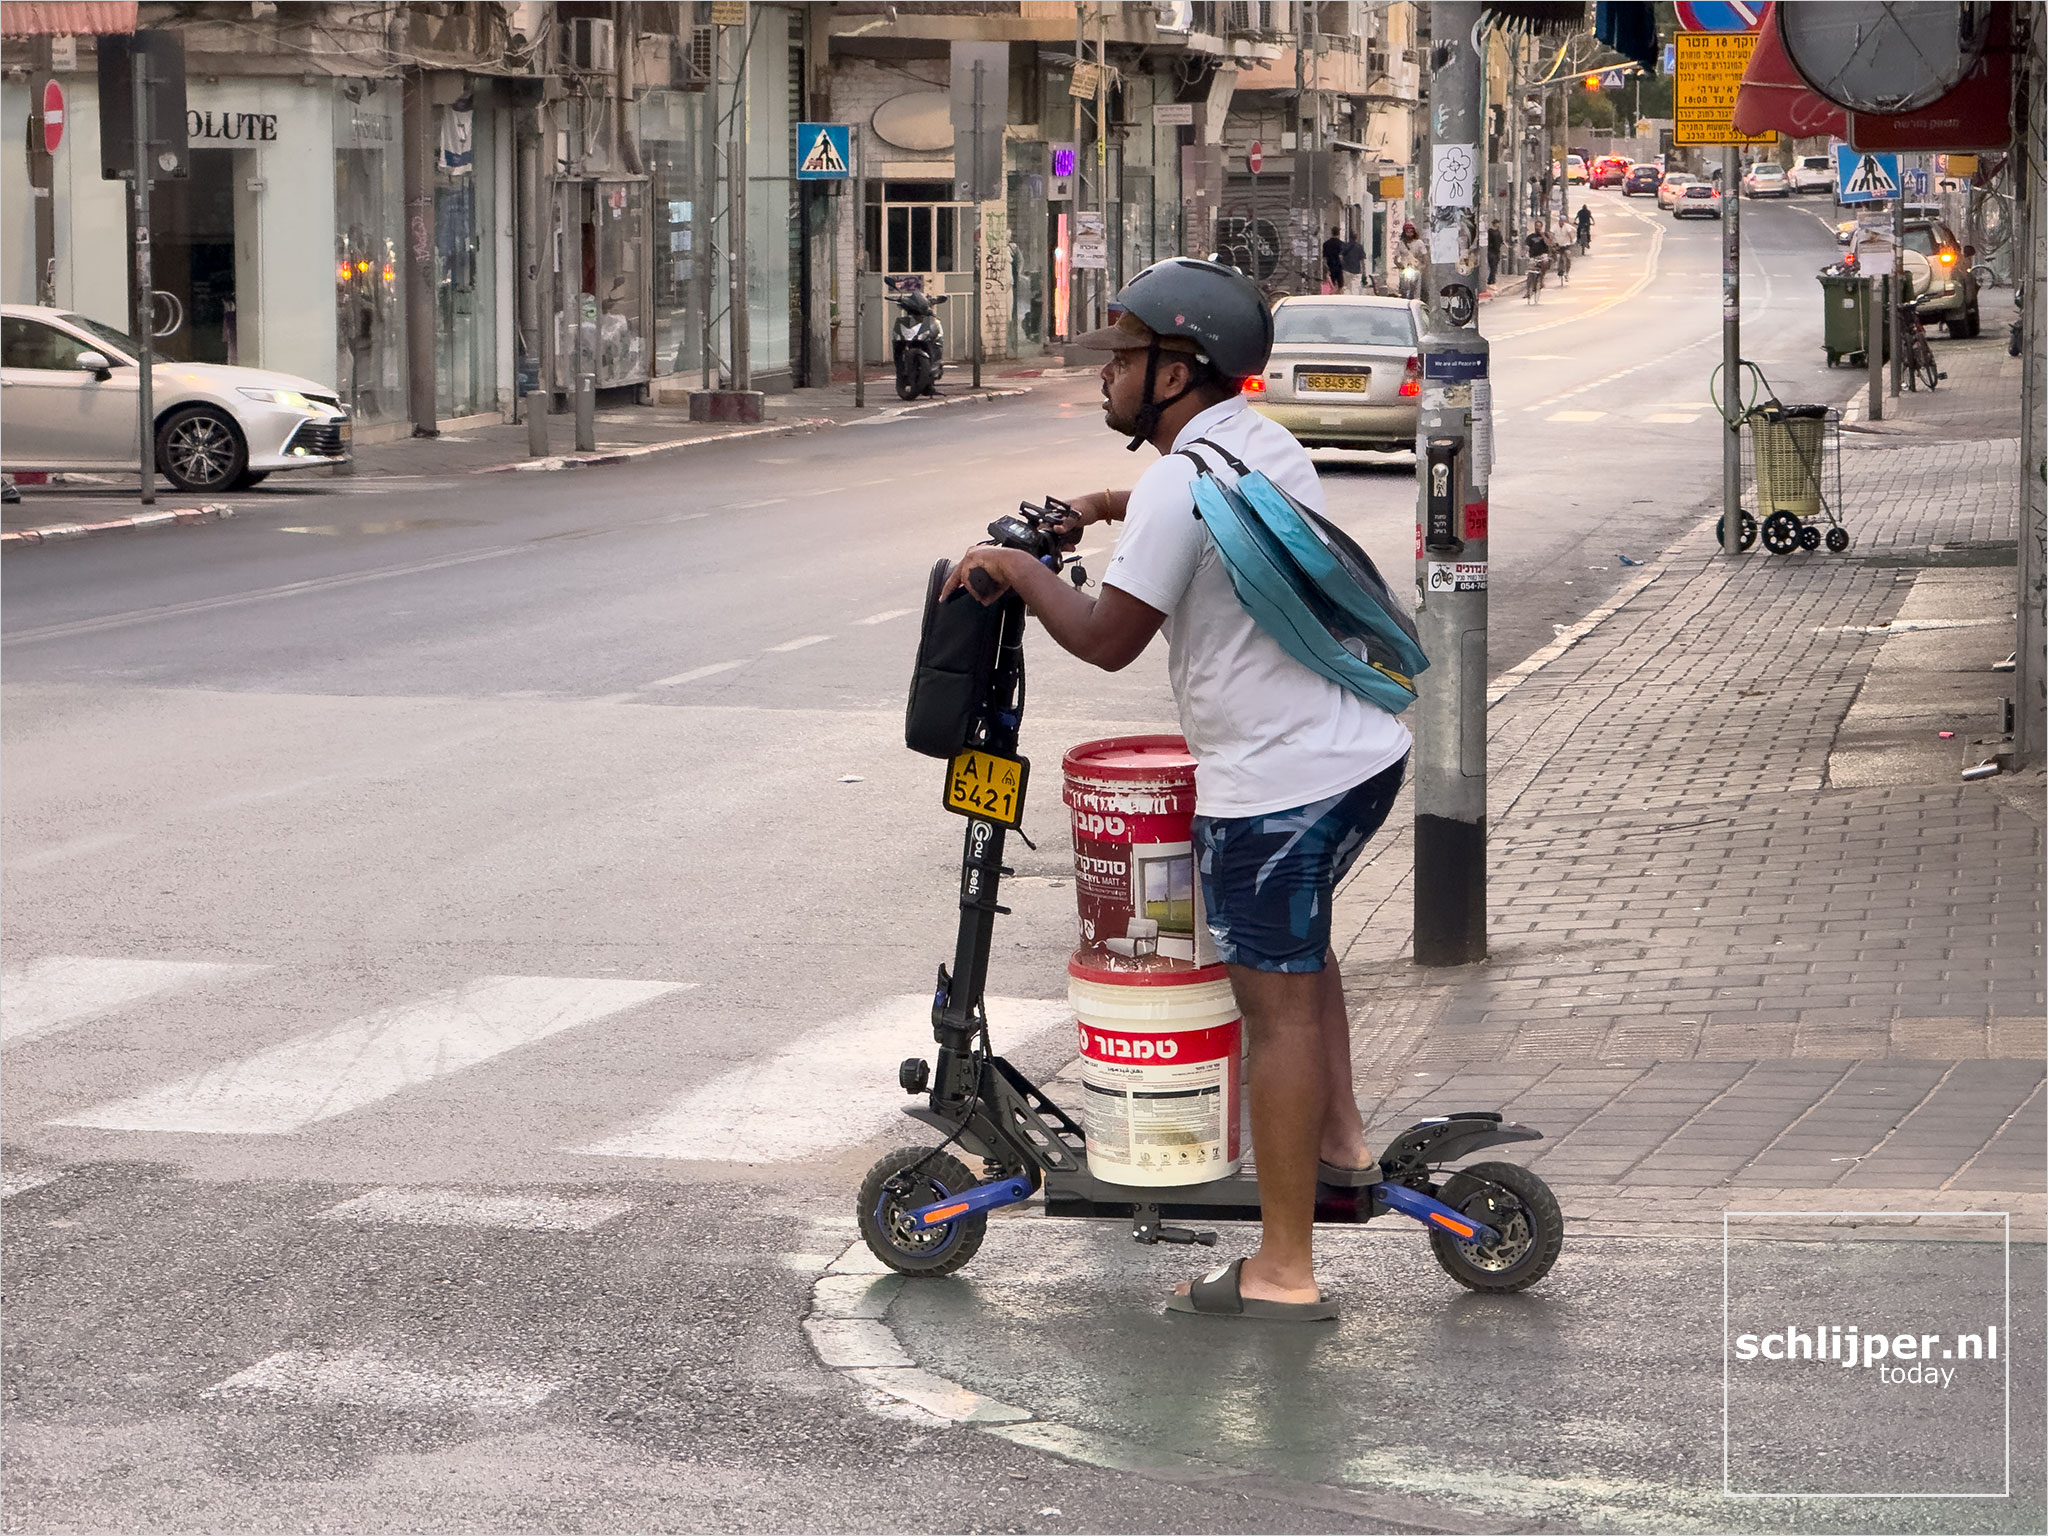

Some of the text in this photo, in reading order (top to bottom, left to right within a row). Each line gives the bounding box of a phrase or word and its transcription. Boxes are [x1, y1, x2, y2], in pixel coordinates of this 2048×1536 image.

[1686, 37, 1709, 47] מטר
[1716, 37, 1727, 47] 18
[1684, 96, 1708, 104] 18:00
[953, 778, 1012, 816] 5421
[1101, 877, 1120, 886] MATT
[1094, 1034, 1178, 1059] טמבור
